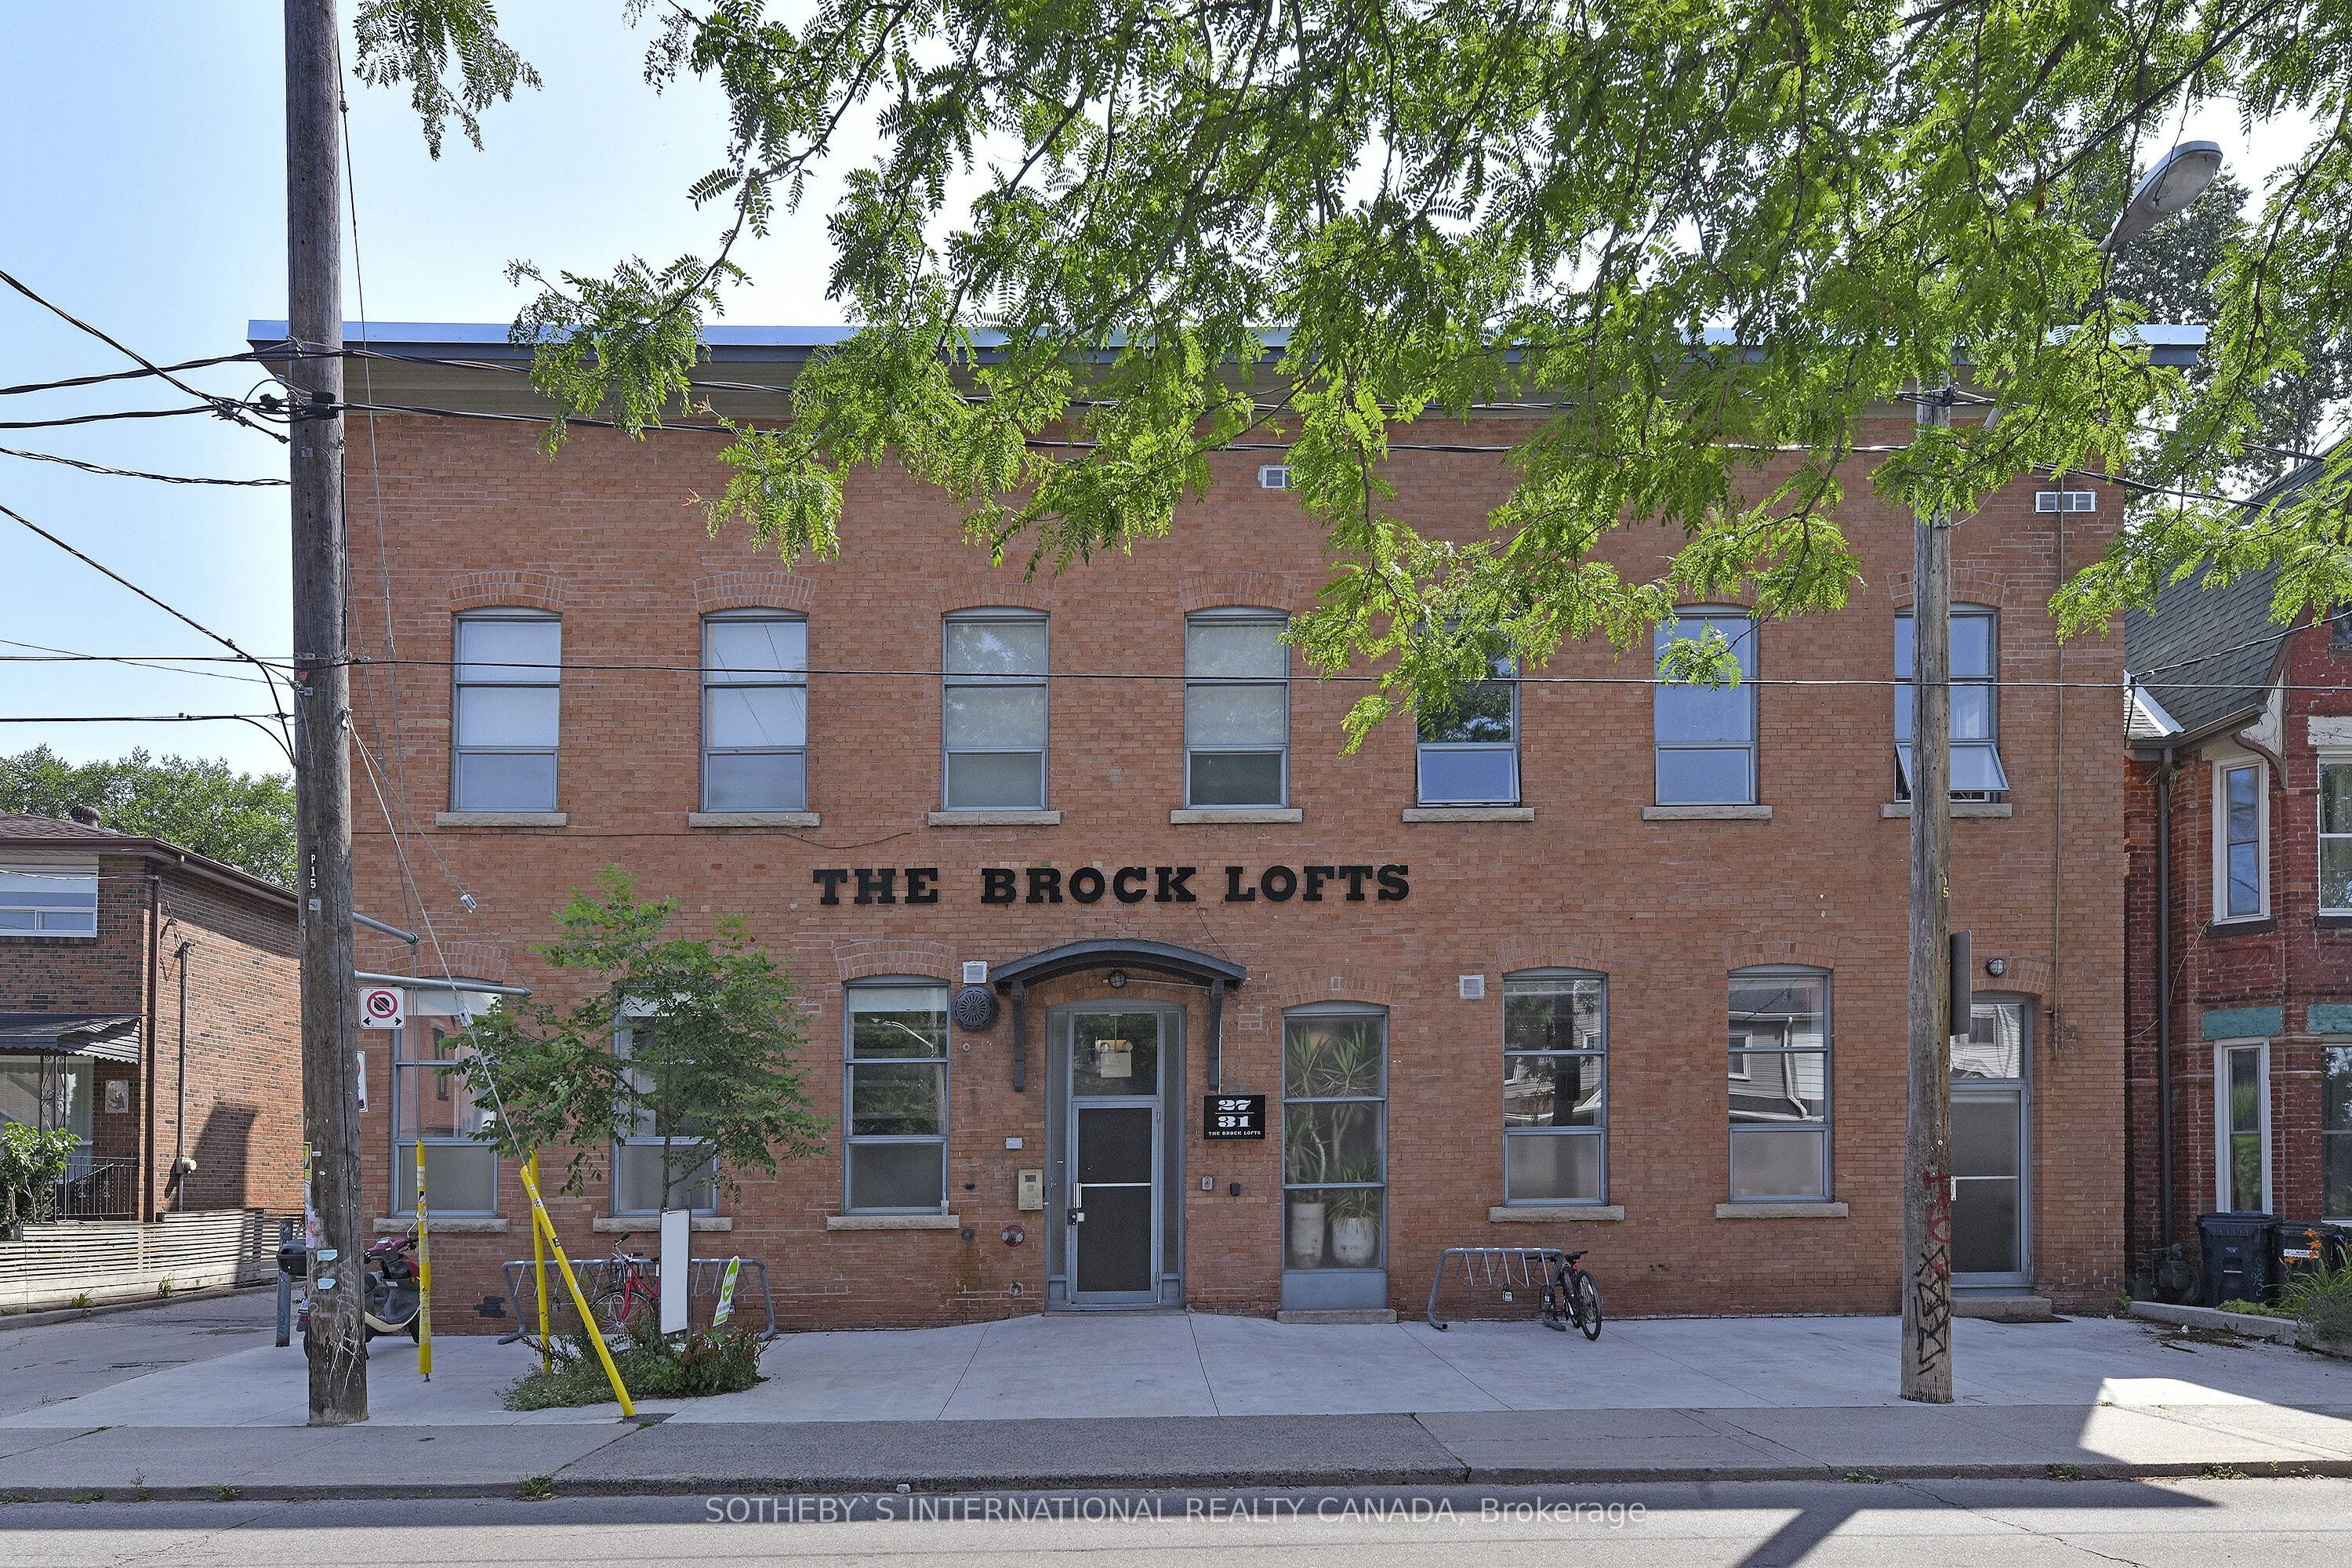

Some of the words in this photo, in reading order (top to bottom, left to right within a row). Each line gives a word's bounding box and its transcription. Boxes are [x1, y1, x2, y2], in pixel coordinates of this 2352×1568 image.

[813, 868, 938, 905] THE
[981, 866, 1197, 904] BROCK
[1225, 865, 1410, 902] LOFTS
[1218, 1099, 1251, 1111] 27
[1218, 1116, 1251, 1127] 31
